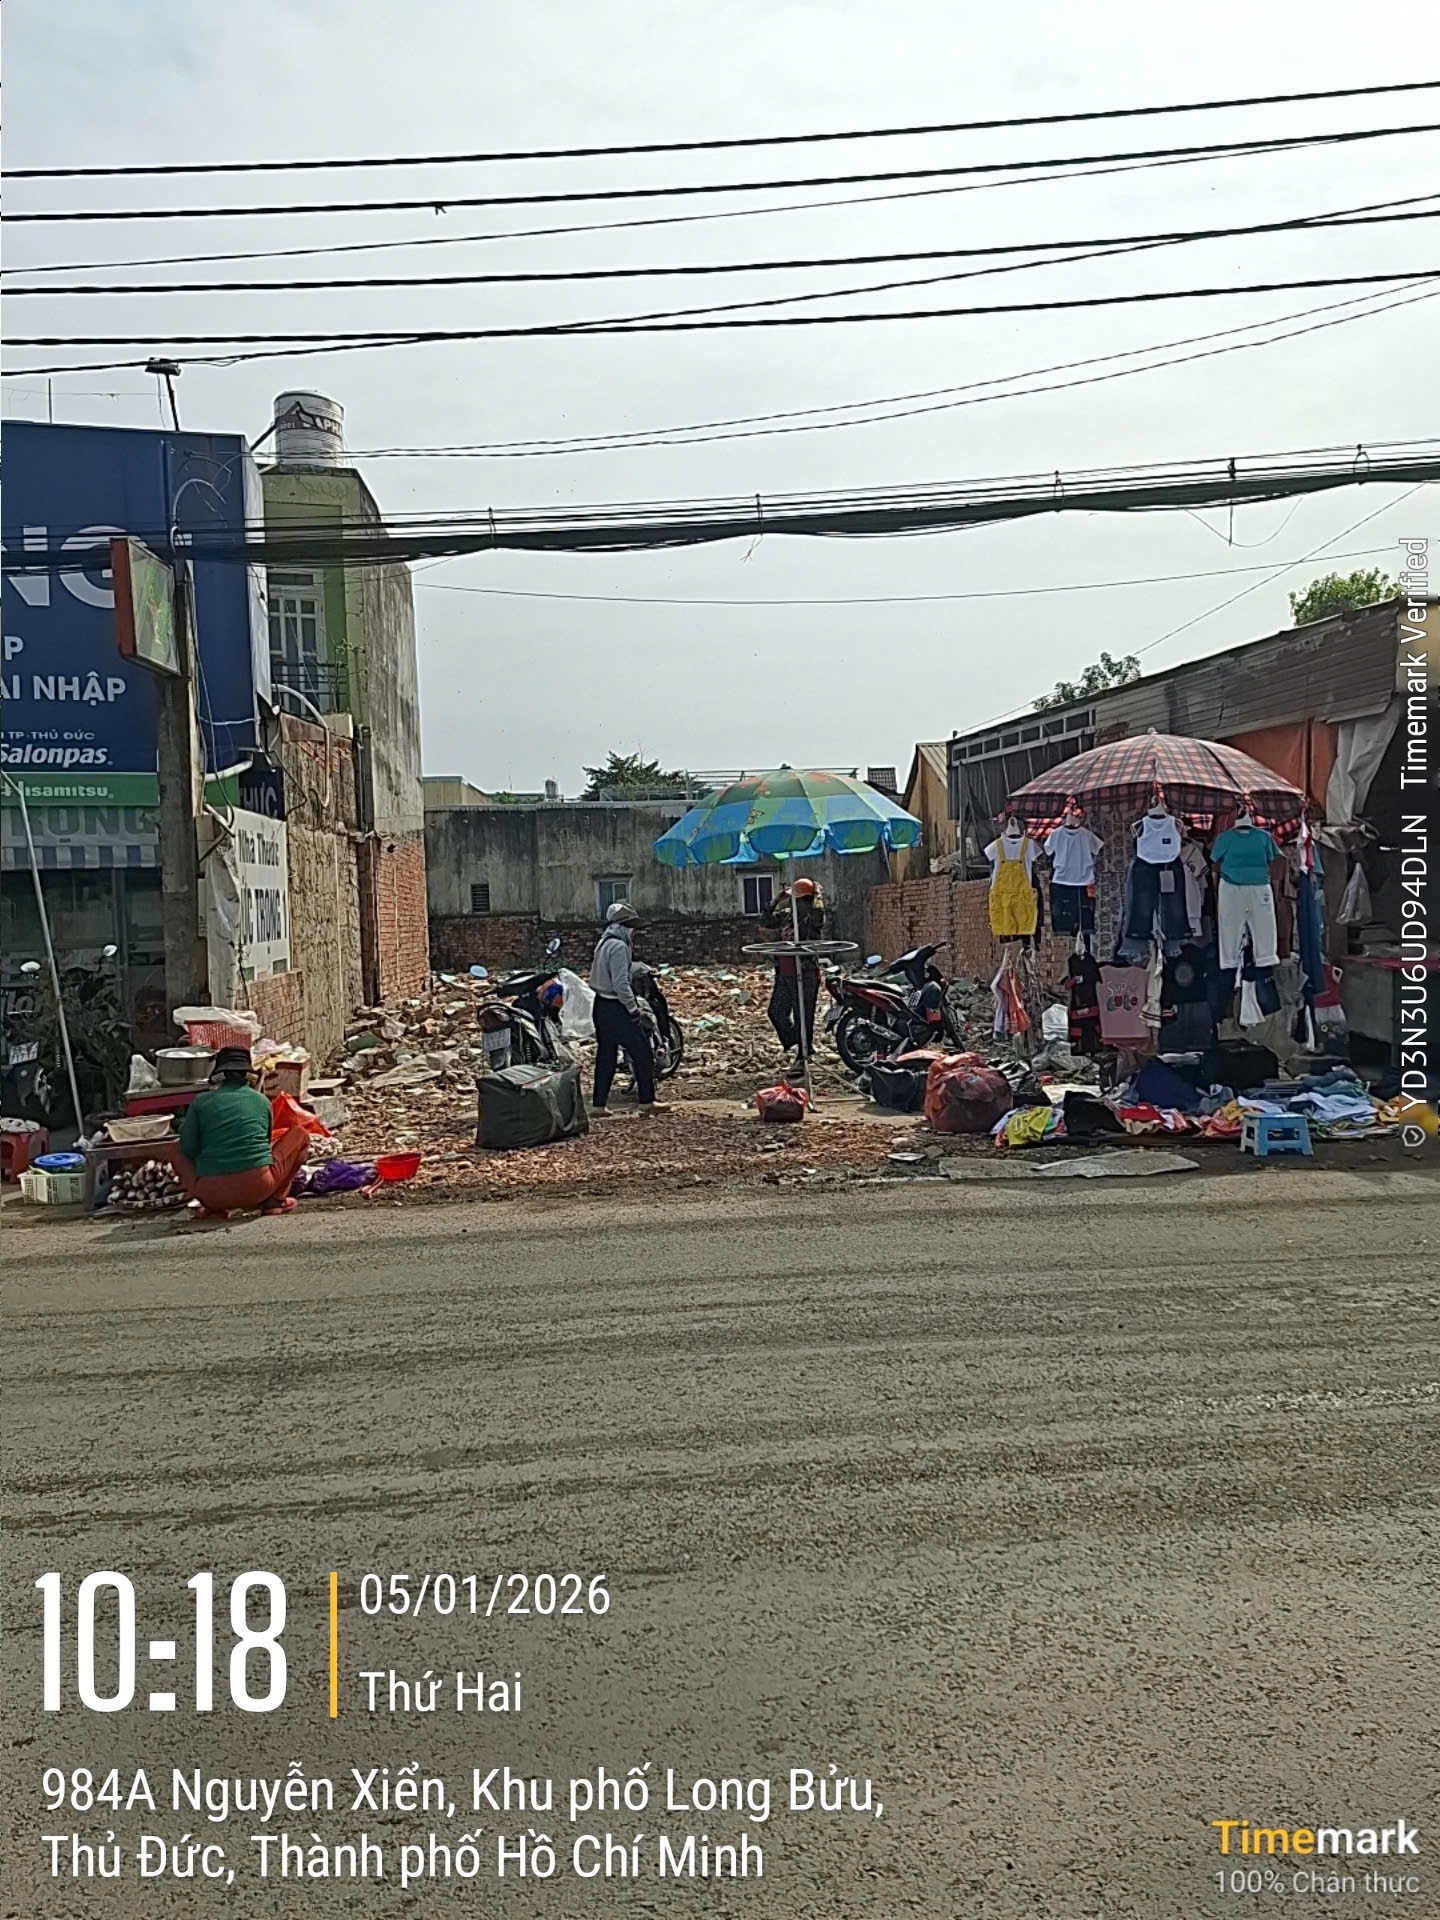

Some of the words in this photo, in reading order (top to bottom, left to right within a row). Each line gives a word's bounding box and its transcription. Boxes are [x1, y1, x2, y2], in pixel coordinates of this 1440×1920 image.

[33, 671, 126, 706] NHẬP
[238, 828, 255, 865] Nhà
[257, 830, 280, 867] Thuốc
[255, 887, 281, 954] TRỌNG
